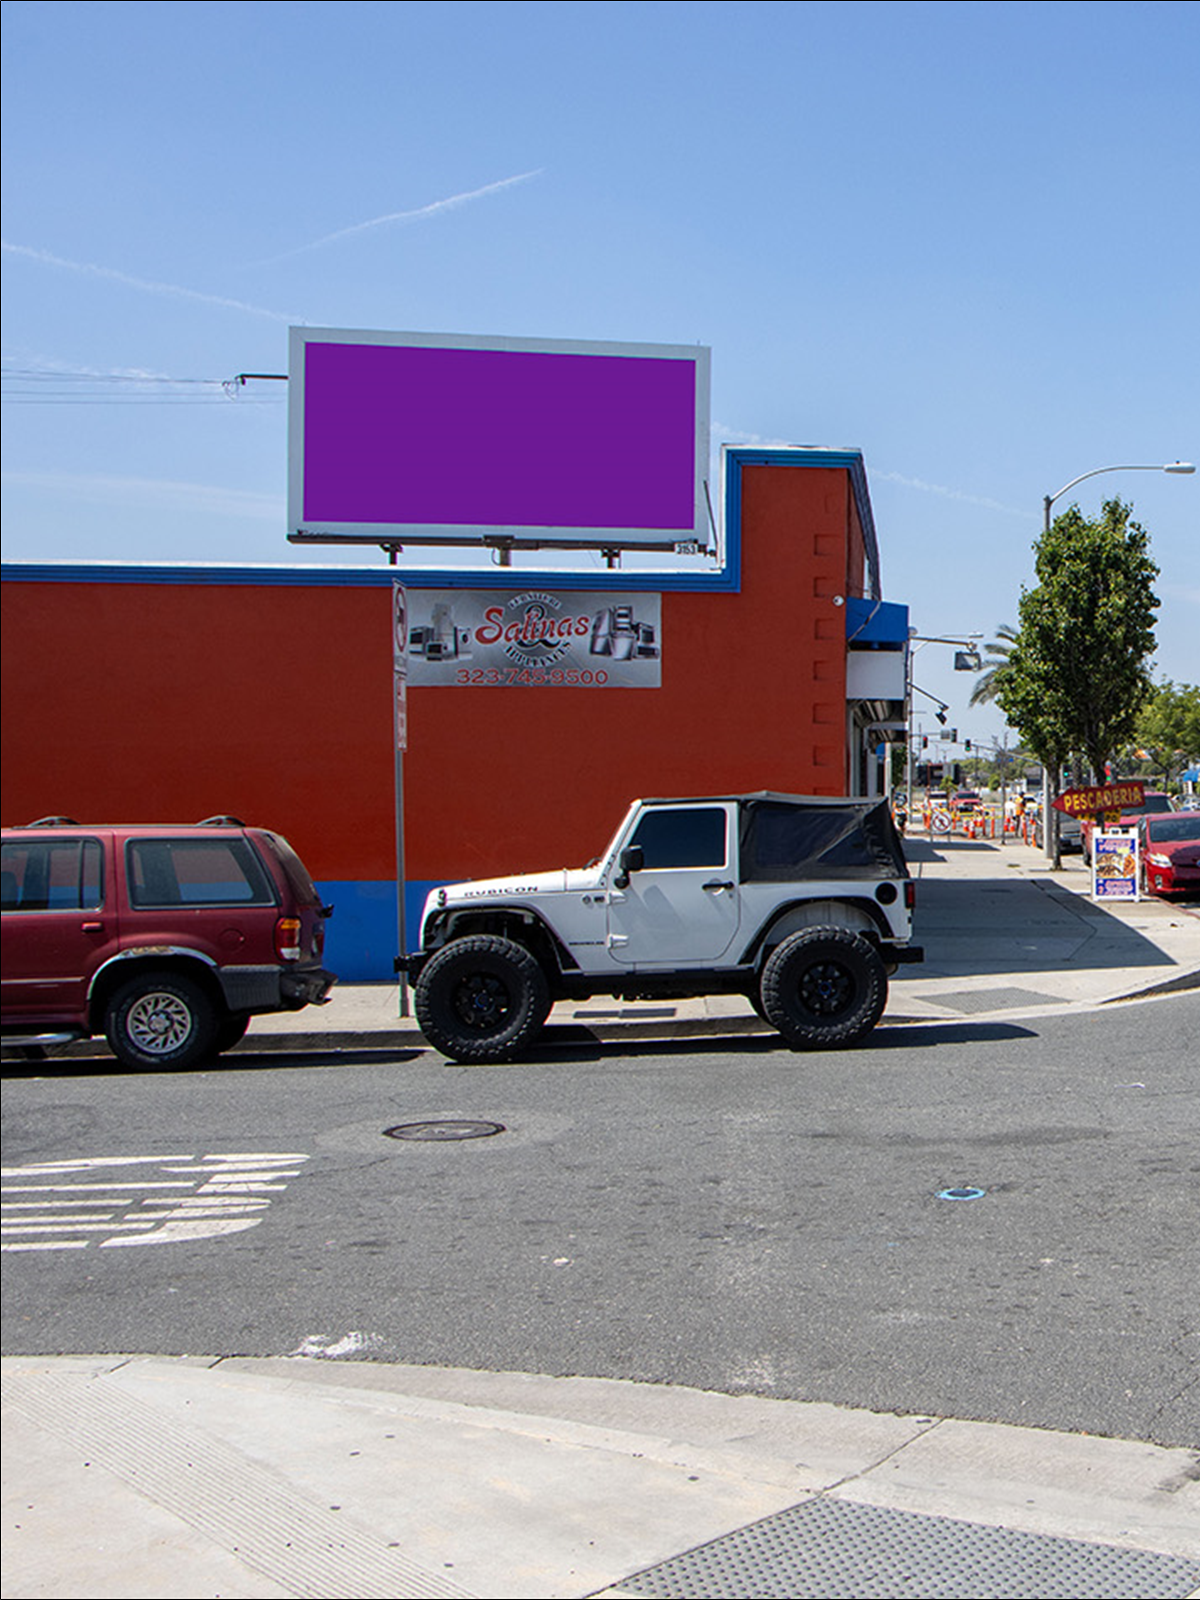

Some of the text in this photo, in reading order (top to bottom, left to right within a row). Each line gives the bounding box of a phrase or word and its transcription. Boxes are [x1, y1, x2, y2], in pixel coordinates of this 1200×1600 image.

[475, 606, 589, 645] Salinas
[457, 668, 608, 684] 323-745-9500
[1063, 786, 1142, 811] PESCADERIA
[464, 886, 539, 897] RUBICON
